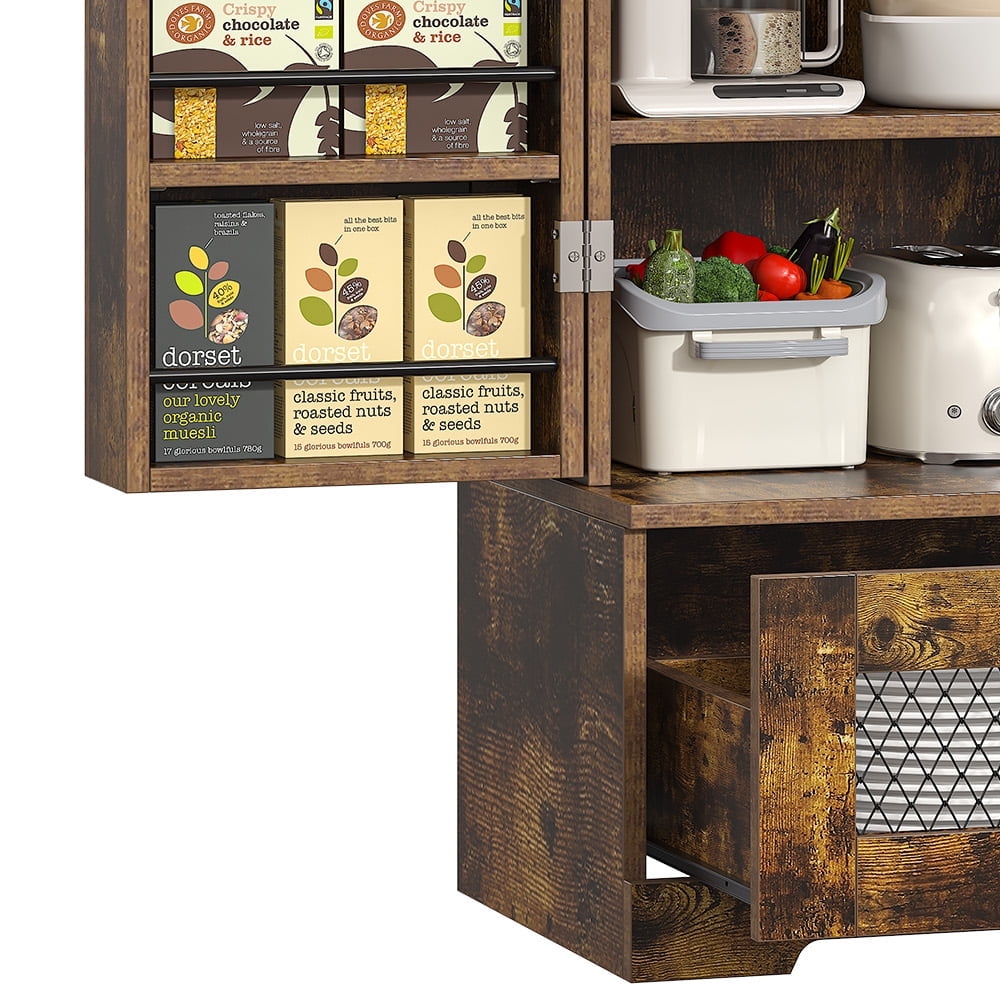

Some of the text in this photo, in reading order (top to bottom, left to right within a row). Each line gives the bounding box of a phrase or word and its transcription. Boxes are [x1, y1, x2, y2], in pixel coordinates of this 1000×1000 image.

[223, 3, 277, 18] Crispy
[413, 0, 466, 16] Crispy
[223, 18, 299, 31] chocolate
[413, 15, 489, 28] chocolate
[223, 34, 271, 46] & rice
[413, 31, 461, 43] & rice
[212, 283, 232, 300] 40%
[162, 346, 242, 366] dorset
[292, 342, 371, 362] dorset
[421, 339, 499, 359] dorset
[294, 388, 396, 403] classic fruits,
[422, 385, 524, 399] classic fruits,
[163, 393, 240, 408] our lovely
[293, 405, 391, 419] roasted nuts
[422, 401, 519, 415] roasted nuts
[163, 410, 222, 426] organic
[422, 418, 481, 431] & seeds
[163, 426, 216, 440] muesli
[294, 422, 353, 435] & seeds
[294, 443, 302, 451] 15
[304, 443, 336, 452] glorious
[372, 441, 391, 449] 700g
[433, 438, 464, 447] glorious
[466, 437, 498, 445] bowlfuls
[174, 447, 206, 456] glorious
[208, 446, 240, 454] bowlfuls
[243, 445, 262, 453] 780g
